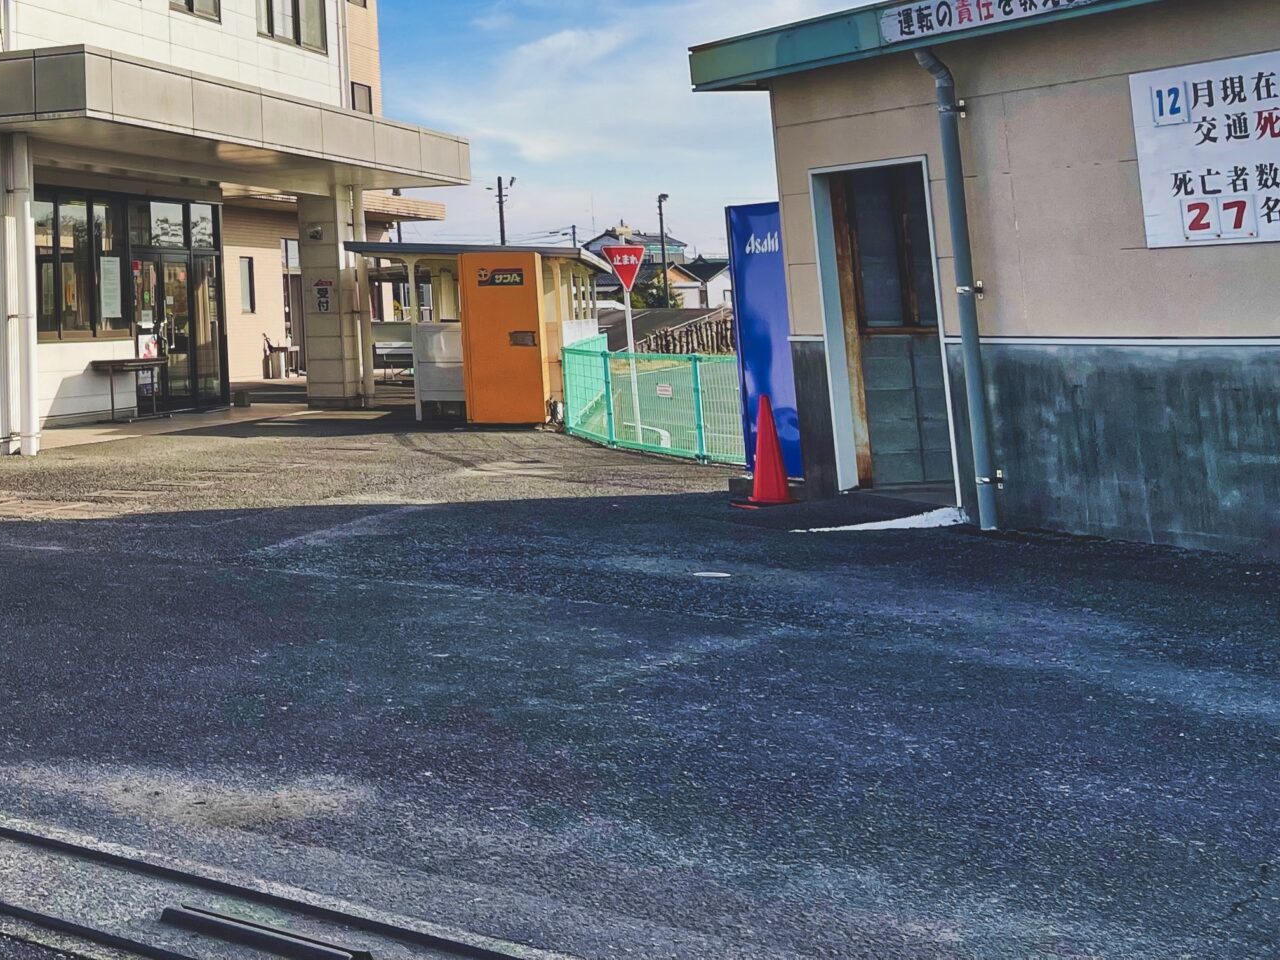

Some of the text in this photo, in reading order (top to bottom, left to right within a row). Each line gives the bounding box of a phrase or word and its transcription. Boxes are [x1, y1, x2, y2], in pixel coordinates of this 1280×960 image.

[1170, 162, 1280, 198] 死亡者数
[745, 230, 779, 255] Asahi
[612, 253, 639, 266] 止まれ
